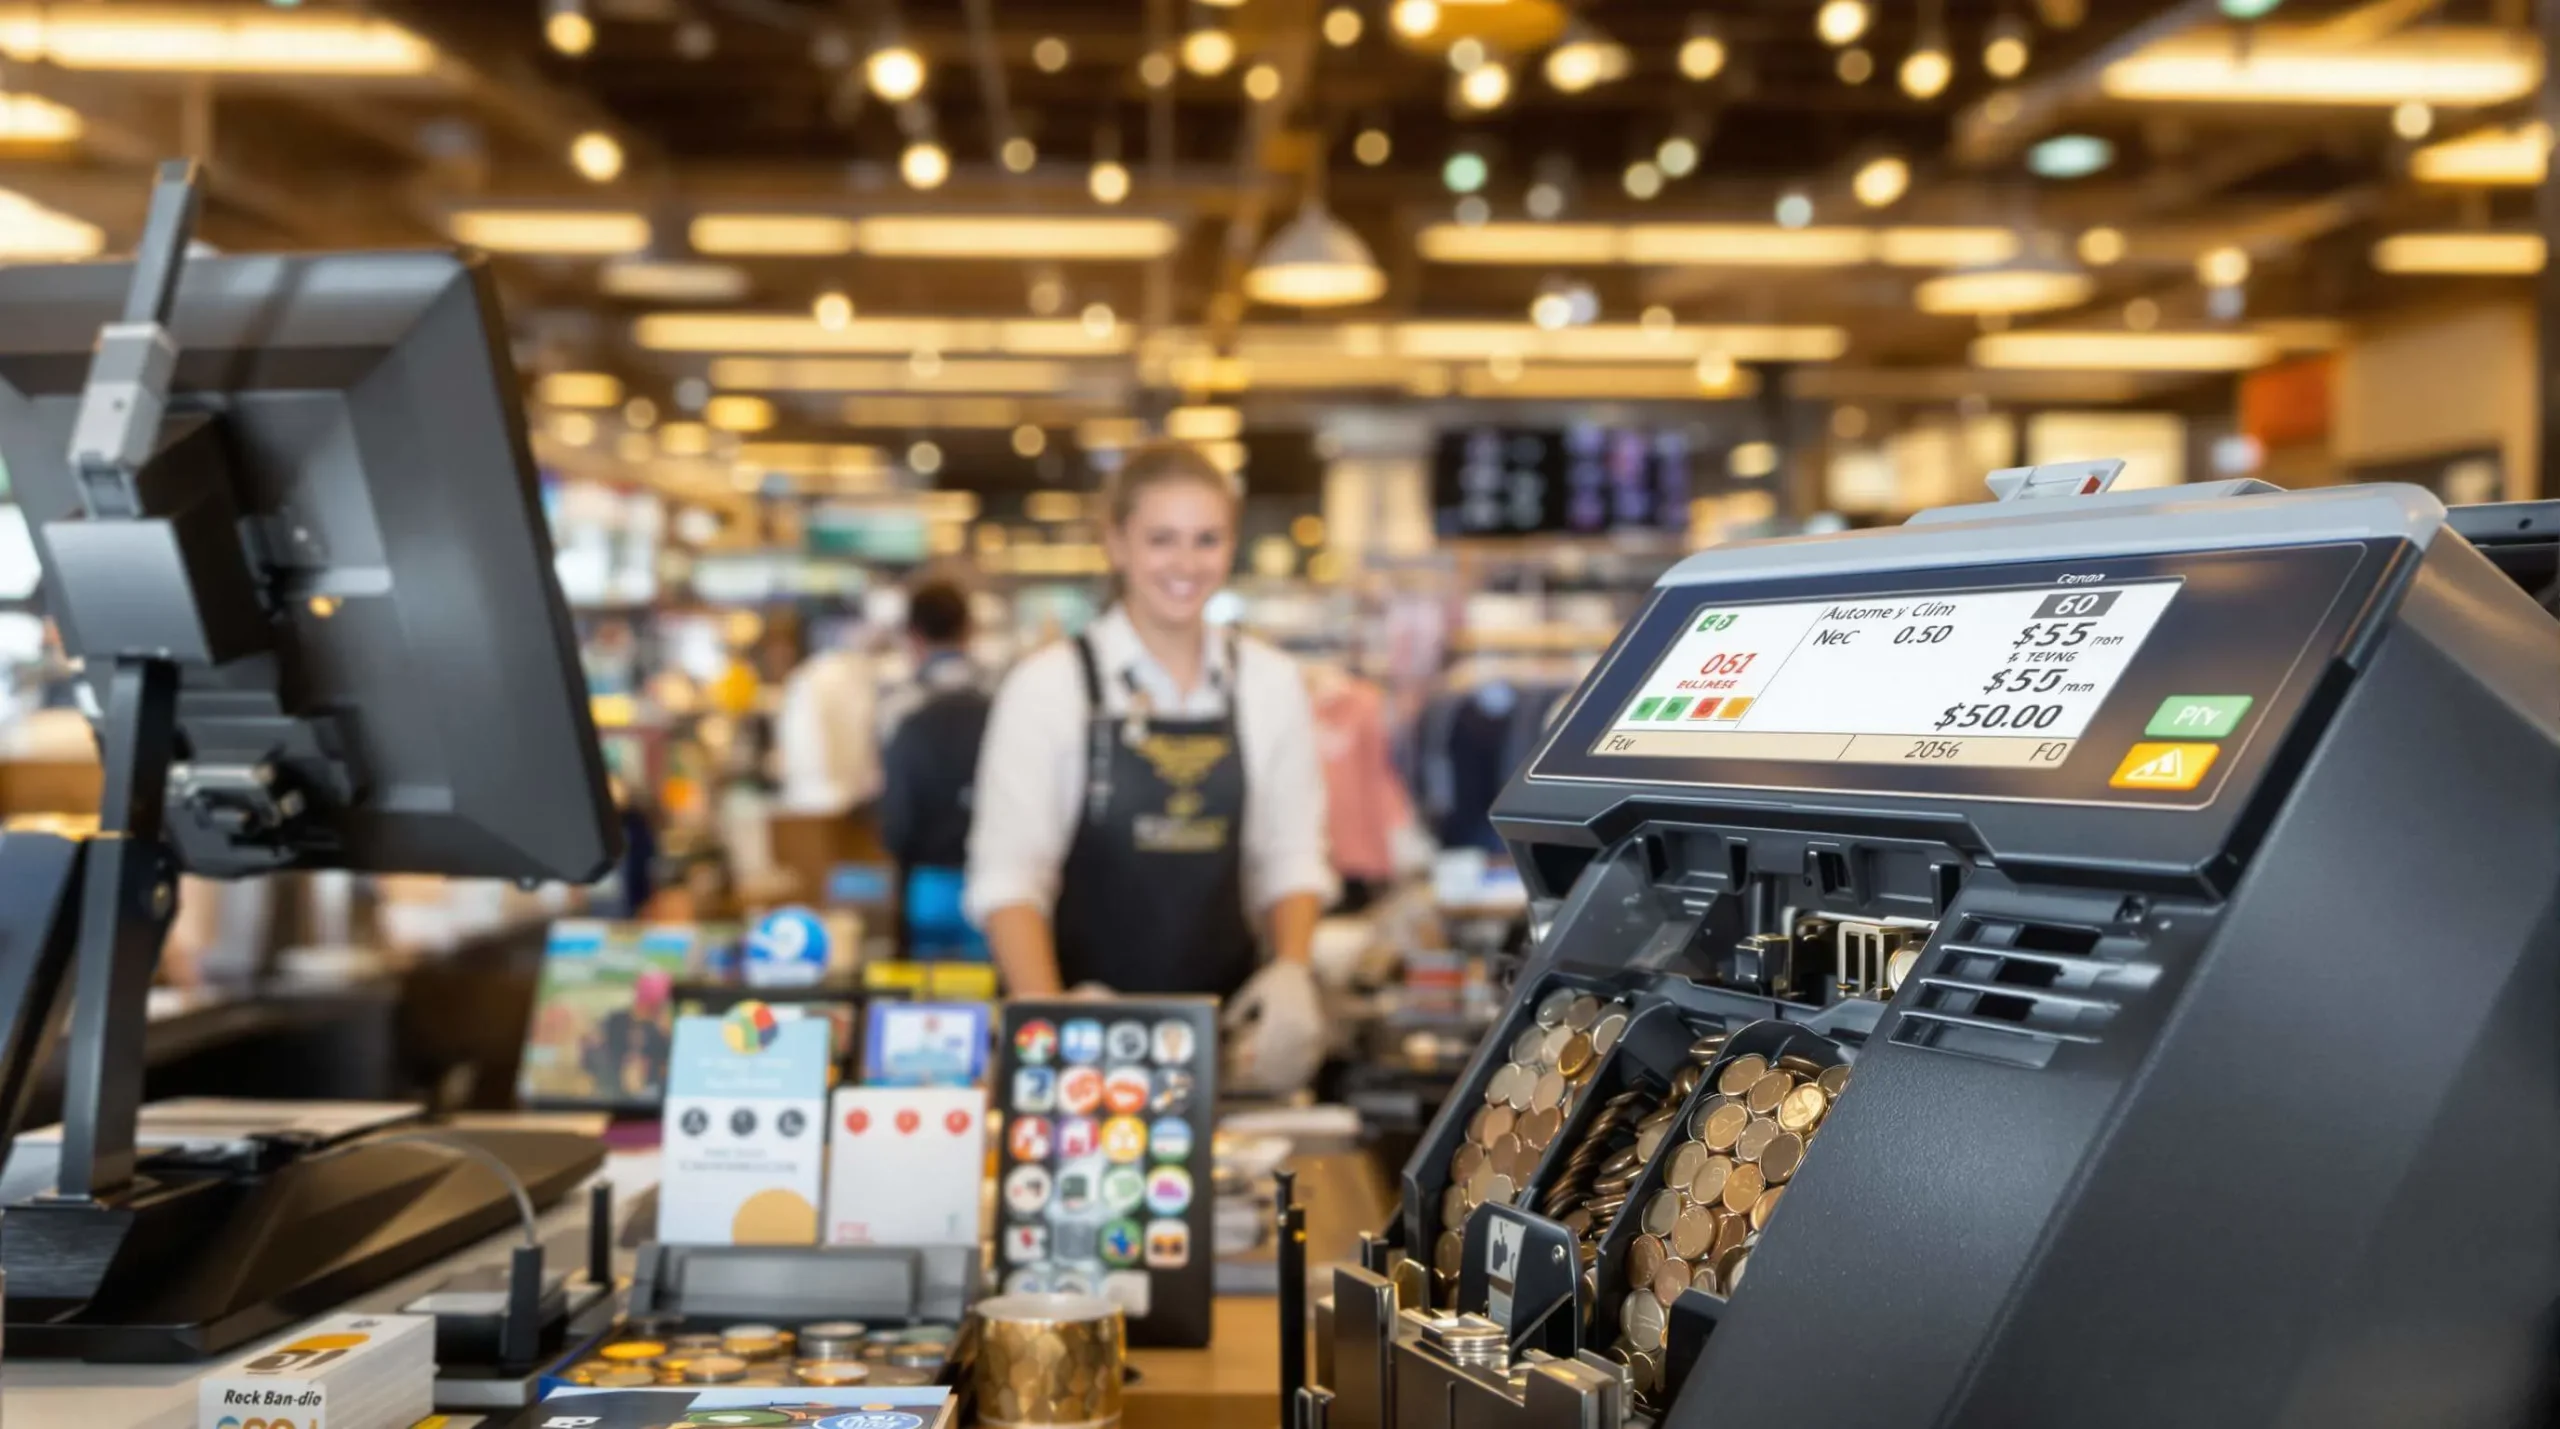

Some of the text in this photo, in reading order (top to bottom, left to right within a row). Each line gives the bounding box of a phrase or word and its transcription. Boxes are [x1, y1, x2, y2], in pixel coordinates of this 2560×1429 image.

[2054, 594, 2099, 615] 60
[1893, 624, 1954, 645] 0.50
[1934, 702, 2063, 731] $50.00
[1904, 740, 1963, 759] 2056
